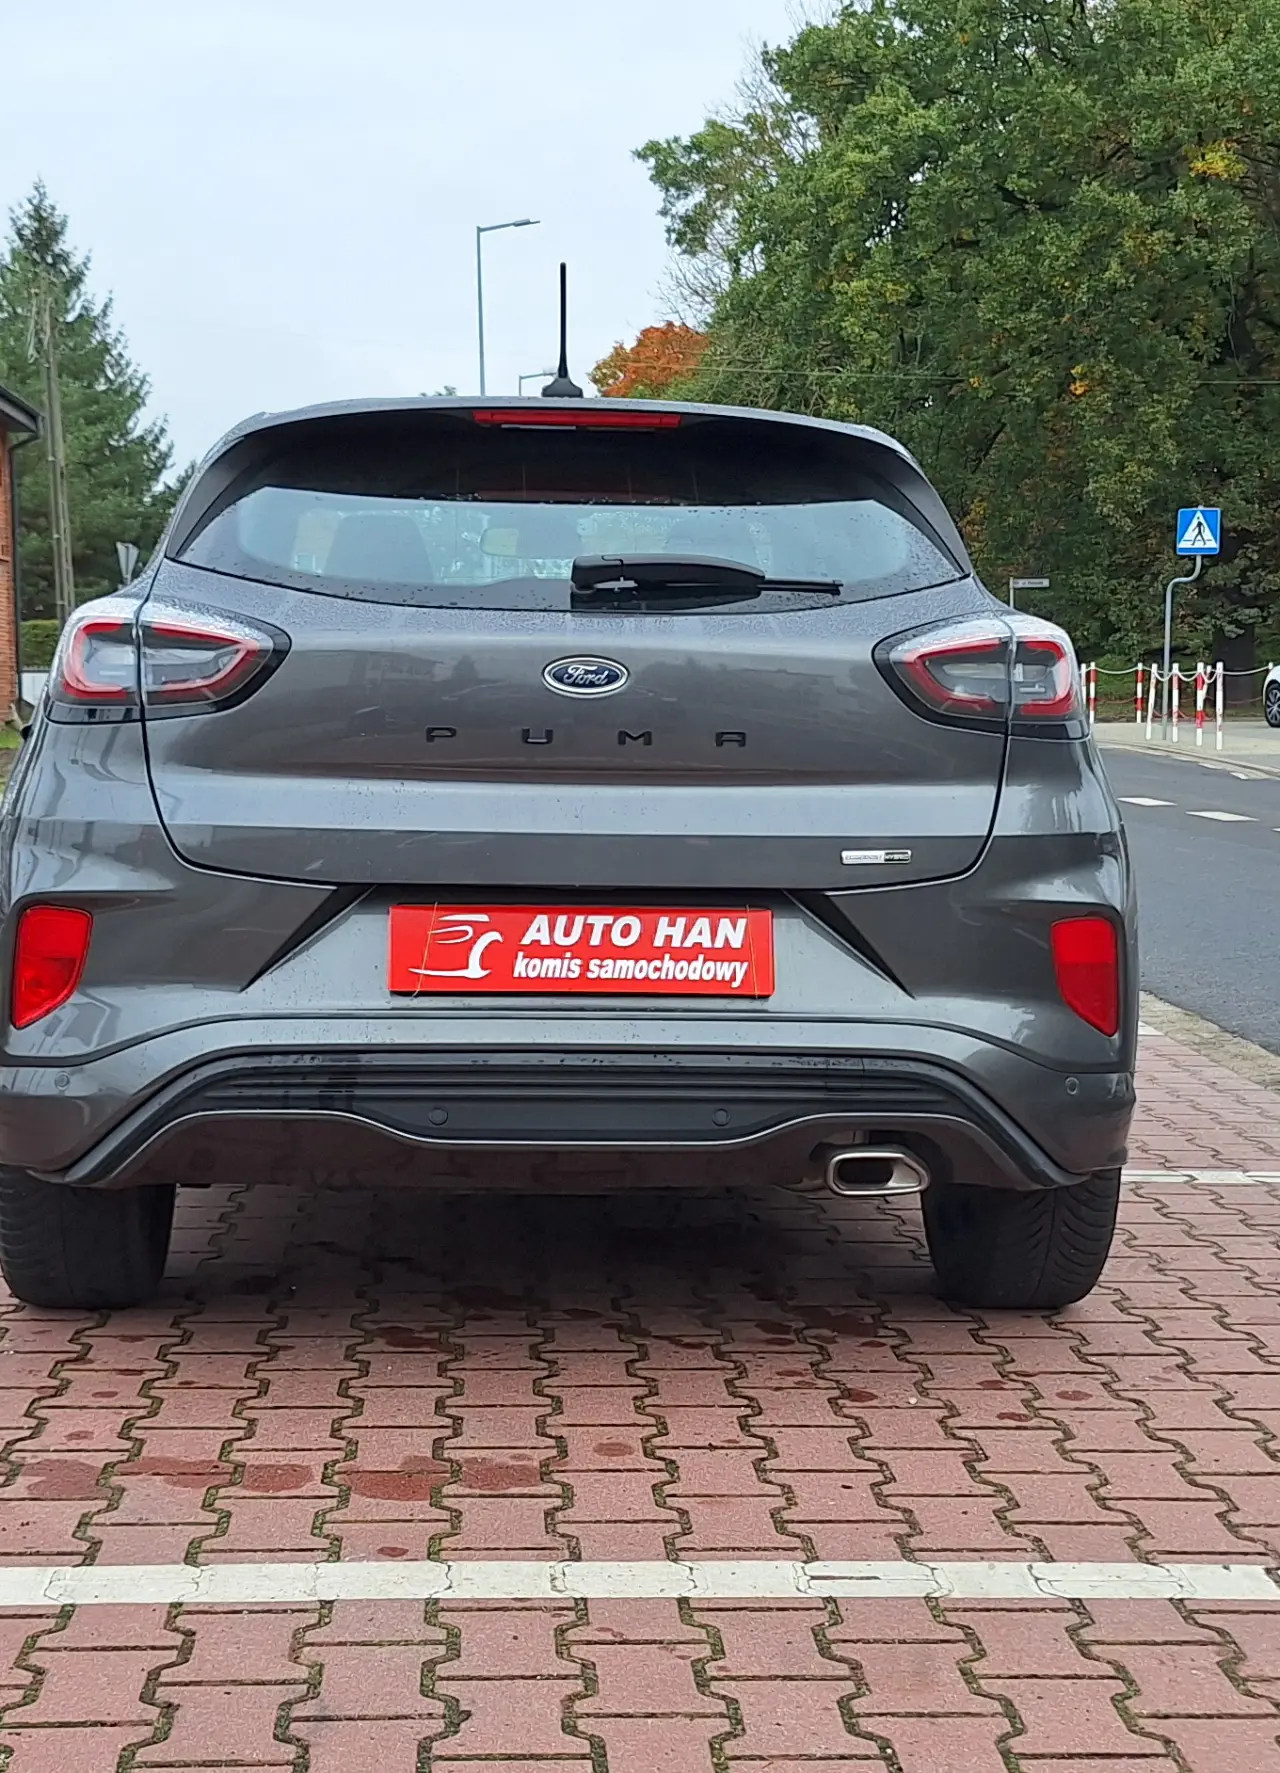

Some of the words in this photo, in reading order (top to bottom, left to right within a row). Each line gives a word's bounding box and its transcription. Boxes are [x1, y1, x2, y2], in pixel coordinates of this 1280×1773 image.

[563, 664, 608, 686] Ford
[425, 726, 746, 748] PUMA
[520, 914, 641, 947] AUTO
[653, 917, 746, 949] HAN
[513, 952, 581, 979] komis
[587, 957, 747, 988] samochodowy
